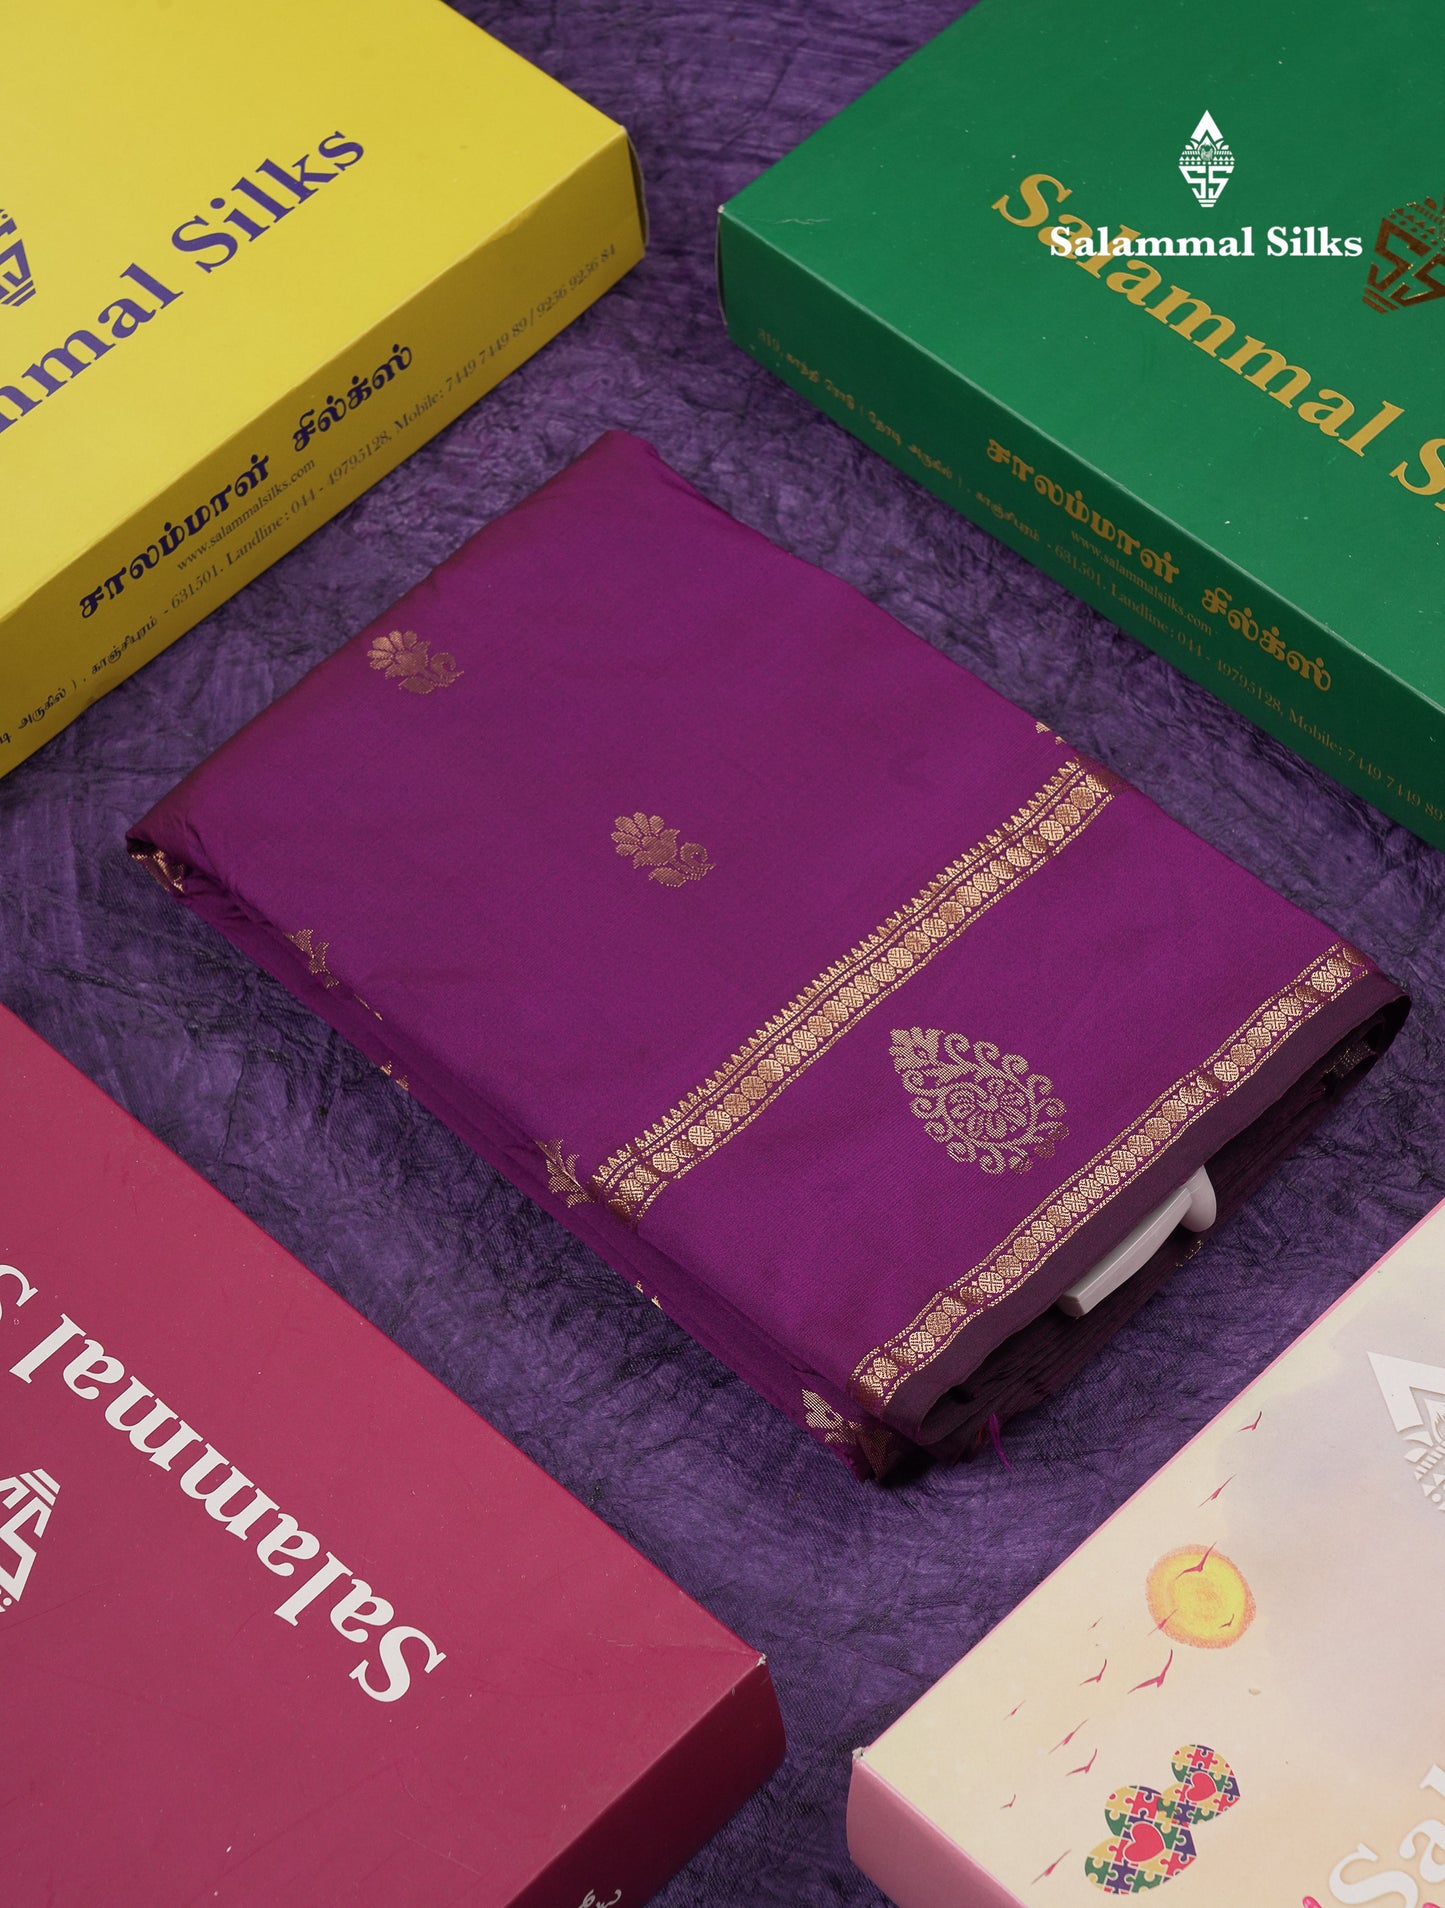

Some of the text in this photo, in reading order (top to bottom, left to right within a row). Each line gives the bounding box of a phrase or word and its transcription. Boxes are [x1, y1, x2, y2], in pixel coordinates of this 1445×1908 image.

[171, 131, 364, 273] Silks
[991, 174, 1404, 456] Salammal
[79, 344, 412, 618] சாலம்மாள் சில்க்ஸ்
[178, 459, 315, 571] www.salammalsilks.com
[987, 439, 1331, 691] சாலம்மாள் சில்க்ஸ்
[1071, 531, 1213, 636] www.salammalsilks.com
[9, 1313, 447, 1703] Salammal
